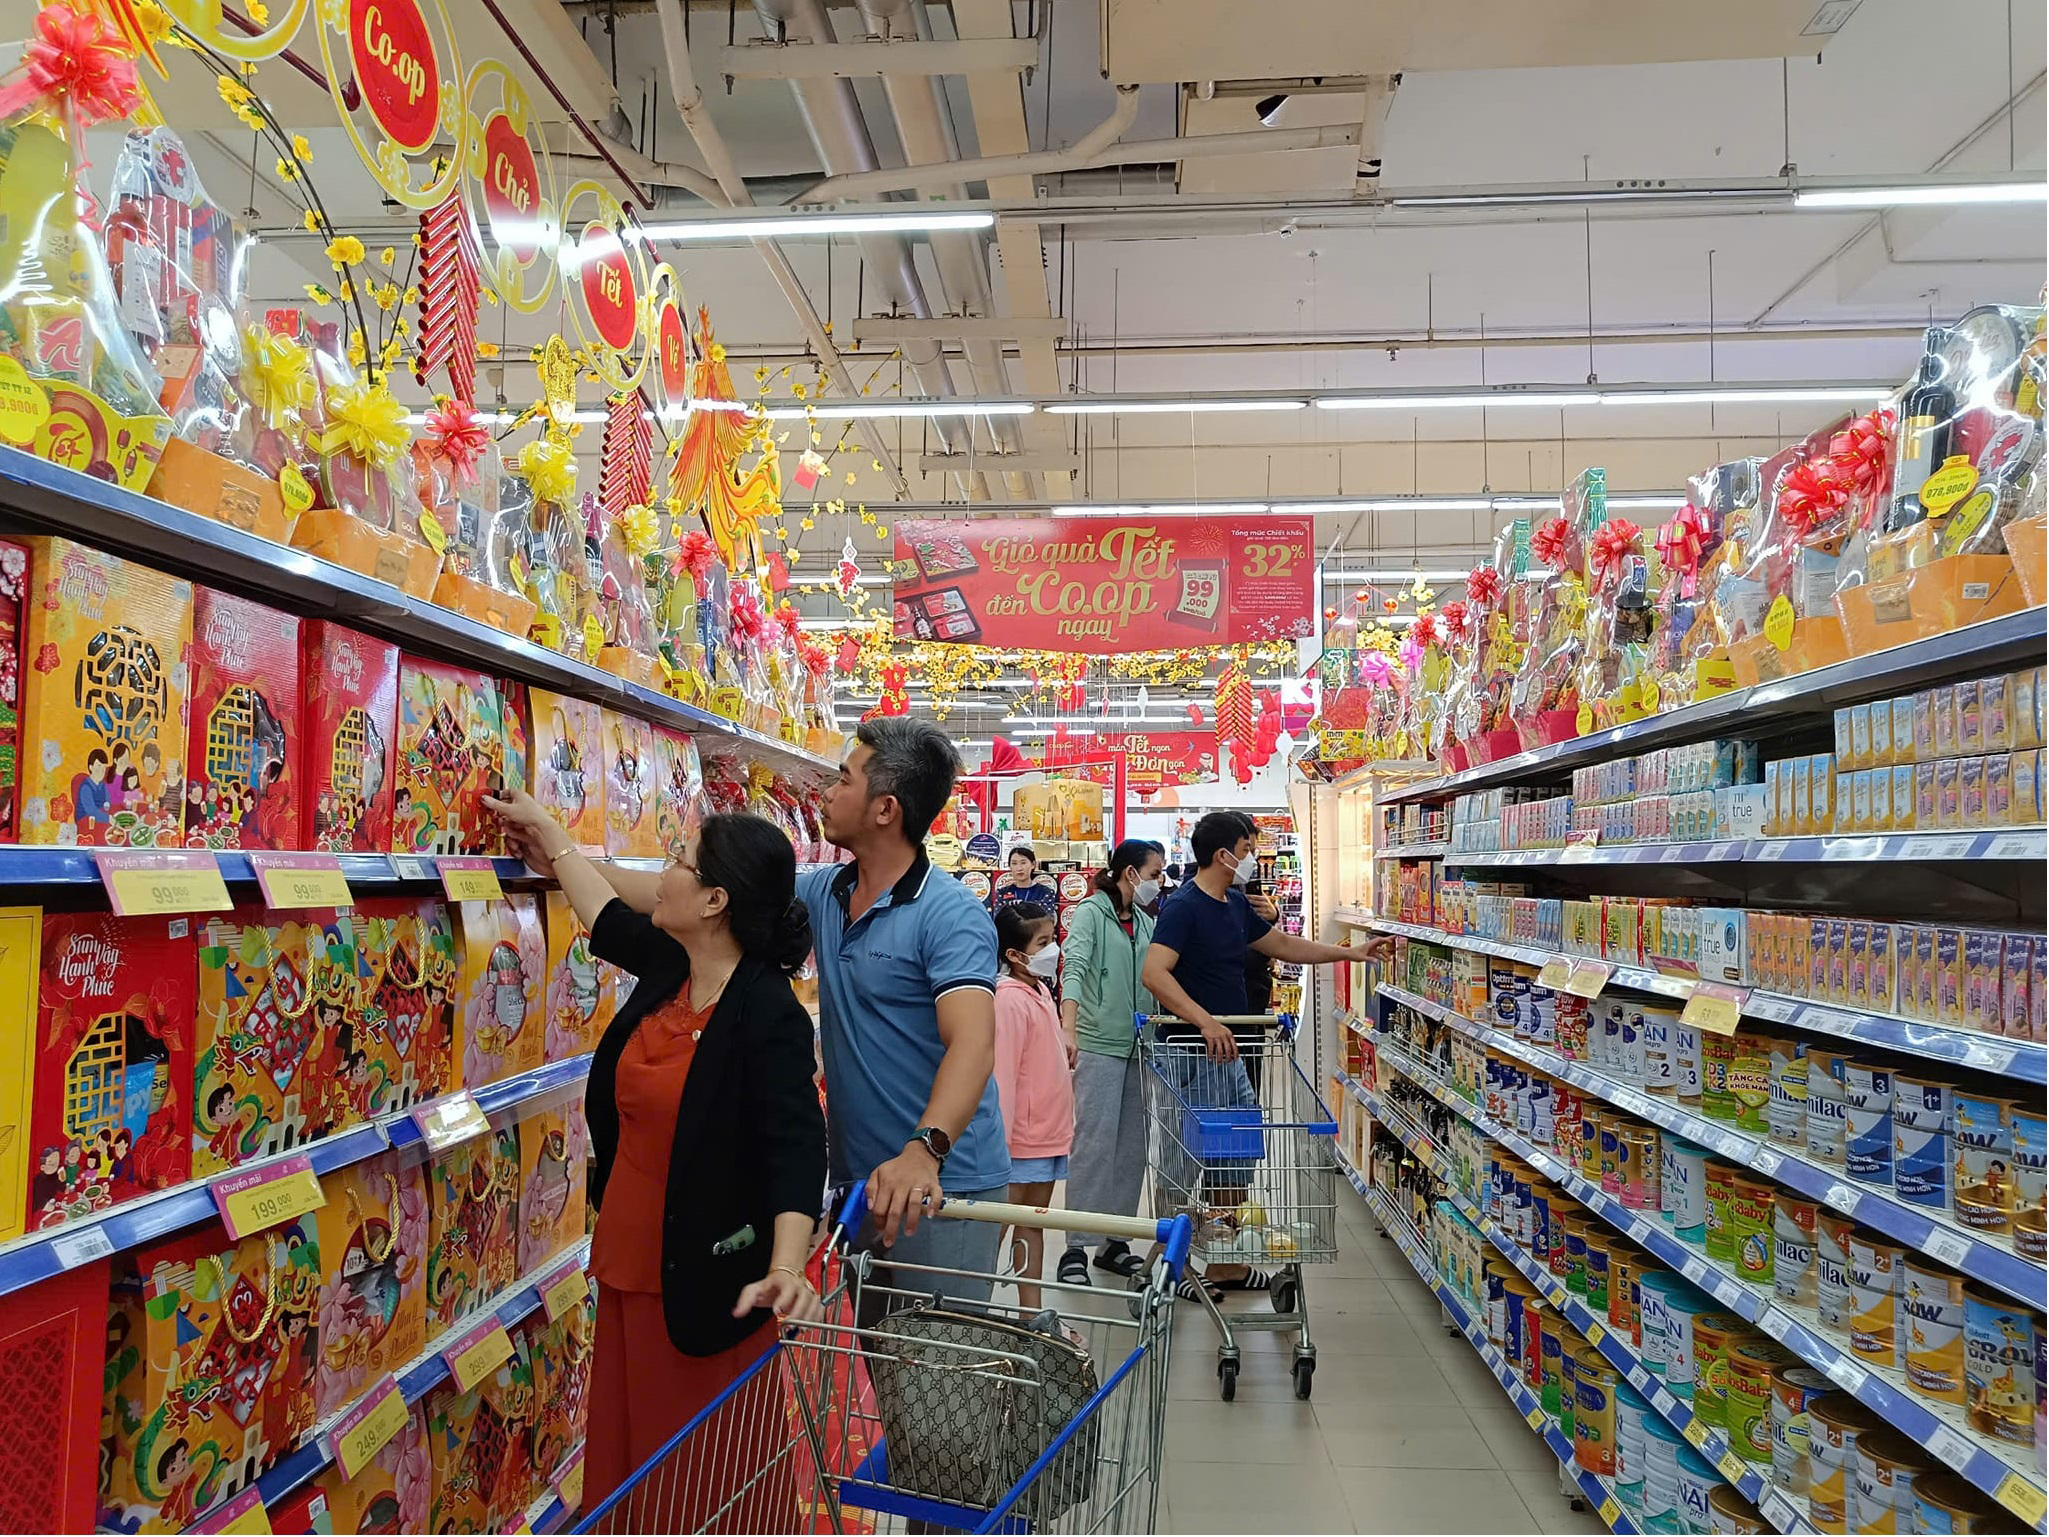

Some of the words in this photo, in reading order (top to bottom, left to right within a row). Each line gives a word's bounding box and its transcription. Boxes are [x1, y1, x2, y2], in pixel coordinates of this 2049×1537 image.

[364, 5, 426, 106] Co.op
[596, 260, 622, 308] Tết
[1041, 534, 1099, 571] quà
[1099, 526, 1177, 580] Tết
[1186, 579, 1214, 598] 99
[1016, 570, 1158, 628] Co.op
[1057, 618, 1120, 643] ngay
[1150, 745, 1171, 753] ngon
[1732, 804, 1752, 818] true
[104, 857, 139, 869] Khuyến
[67, 933, 98, 957] Sum
[1703, 939, 1720, 954] true
[1660, 1063, 1671, 1077] 2
[1688, 1070, 1697, 1085] 3
[1876, 1080, 1885, 1093] 3
[219, 1177, 248, 1194] Khuyến
[1677, 1354, 1684, 1365] 4
[1602, 1450, 1611, 1462] 3
